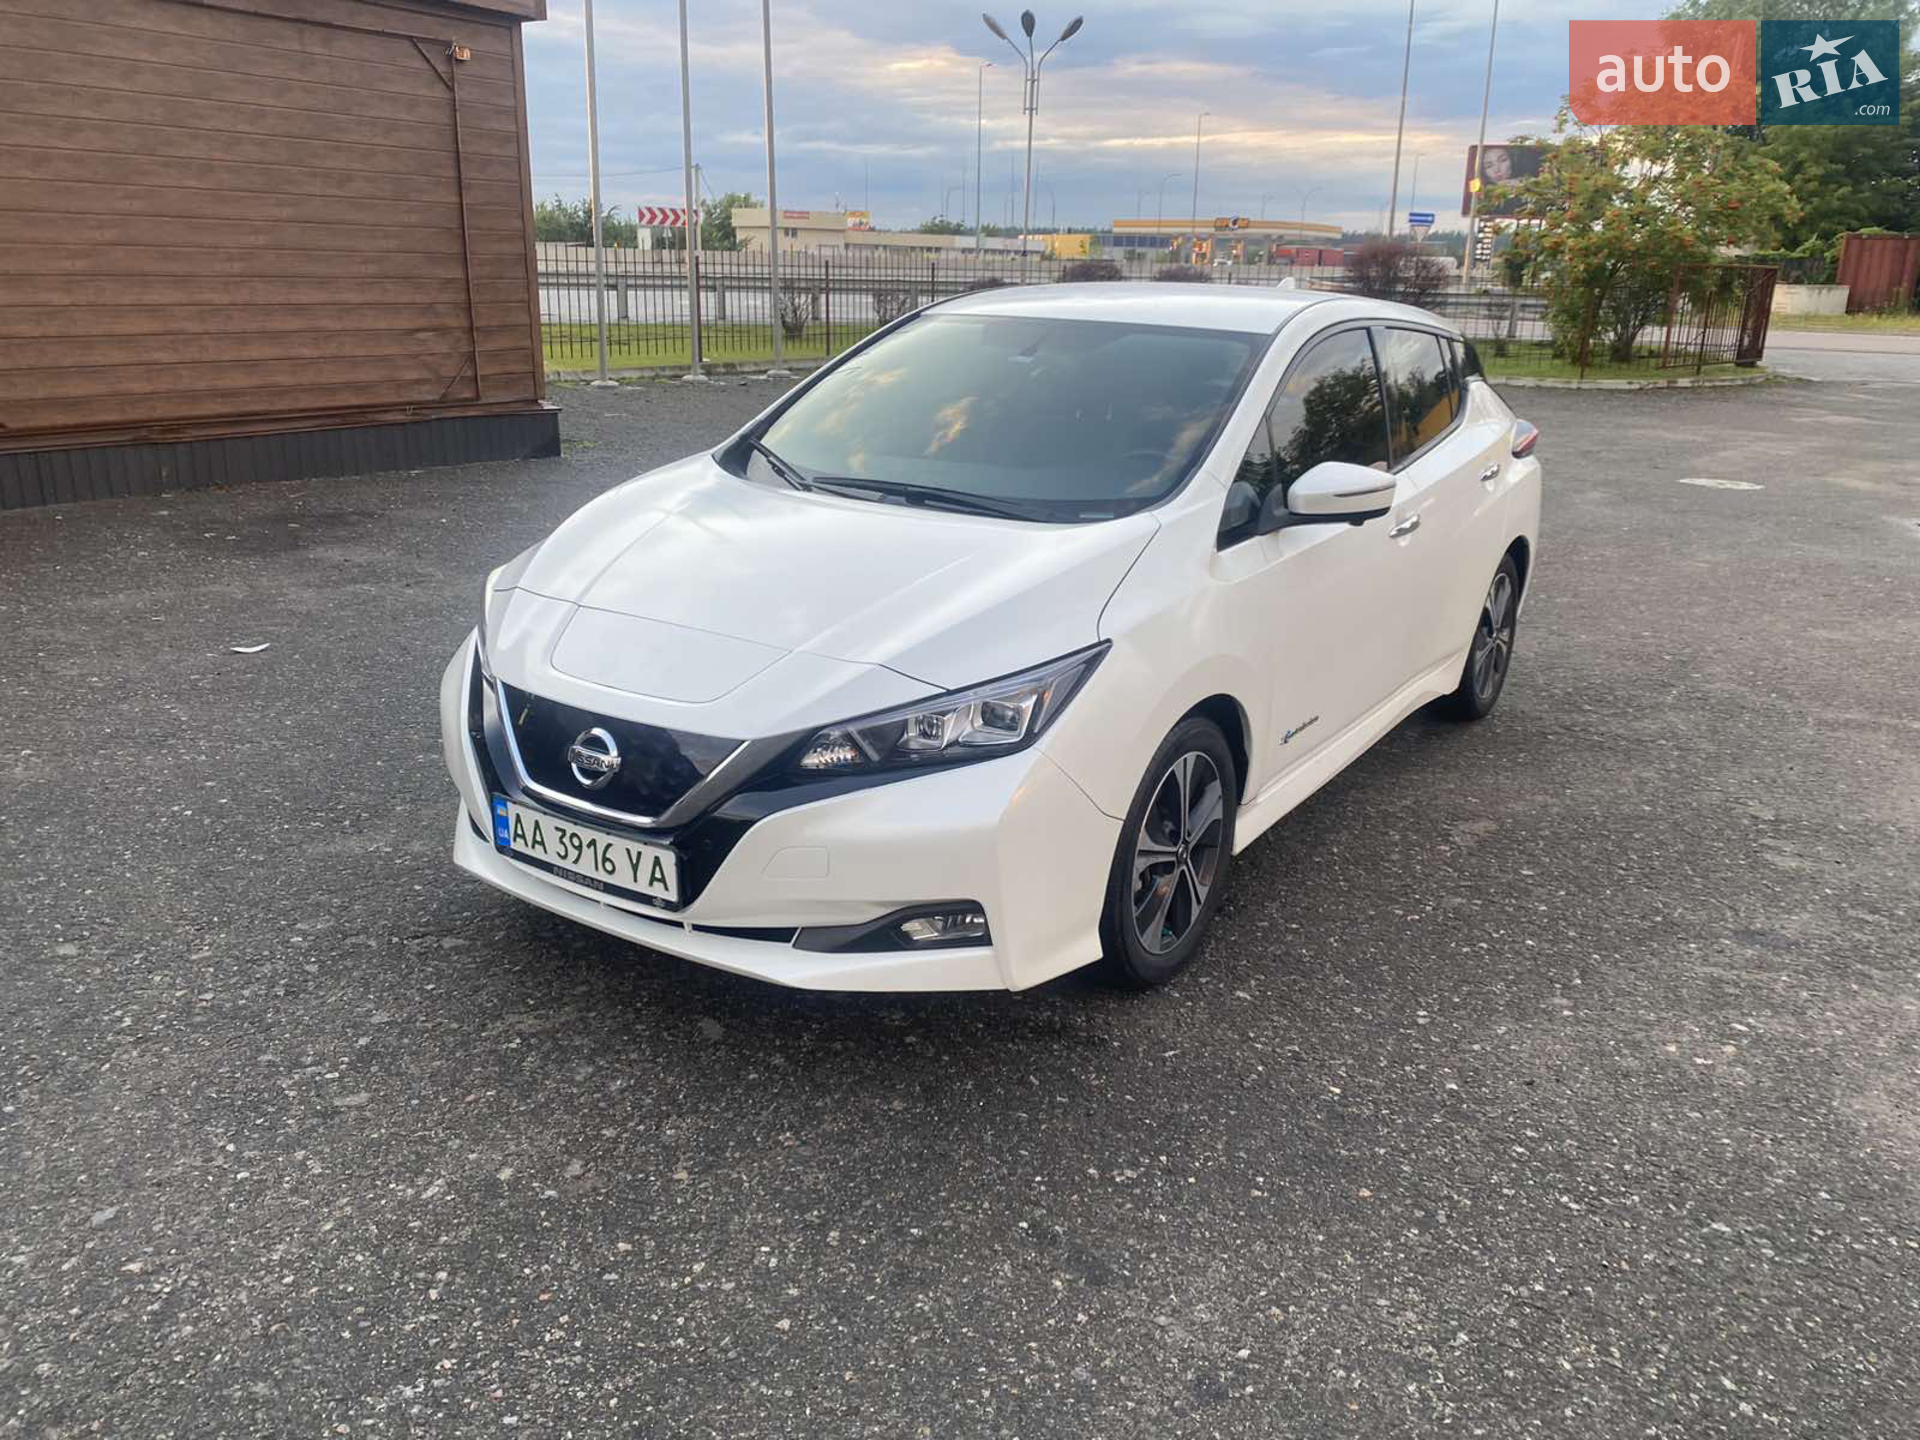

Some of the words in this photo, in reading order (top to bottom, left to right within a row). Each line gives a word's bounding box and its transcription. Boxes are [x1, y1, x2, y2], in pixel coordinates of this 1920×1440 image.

[498, 828, 509, 838] UA
[513, 813, 548, 854] AA
[555, 826, 617, 876] 3916
[625, 847, 669, 892] YA
[552, 866, 604, 891] NISSAN
